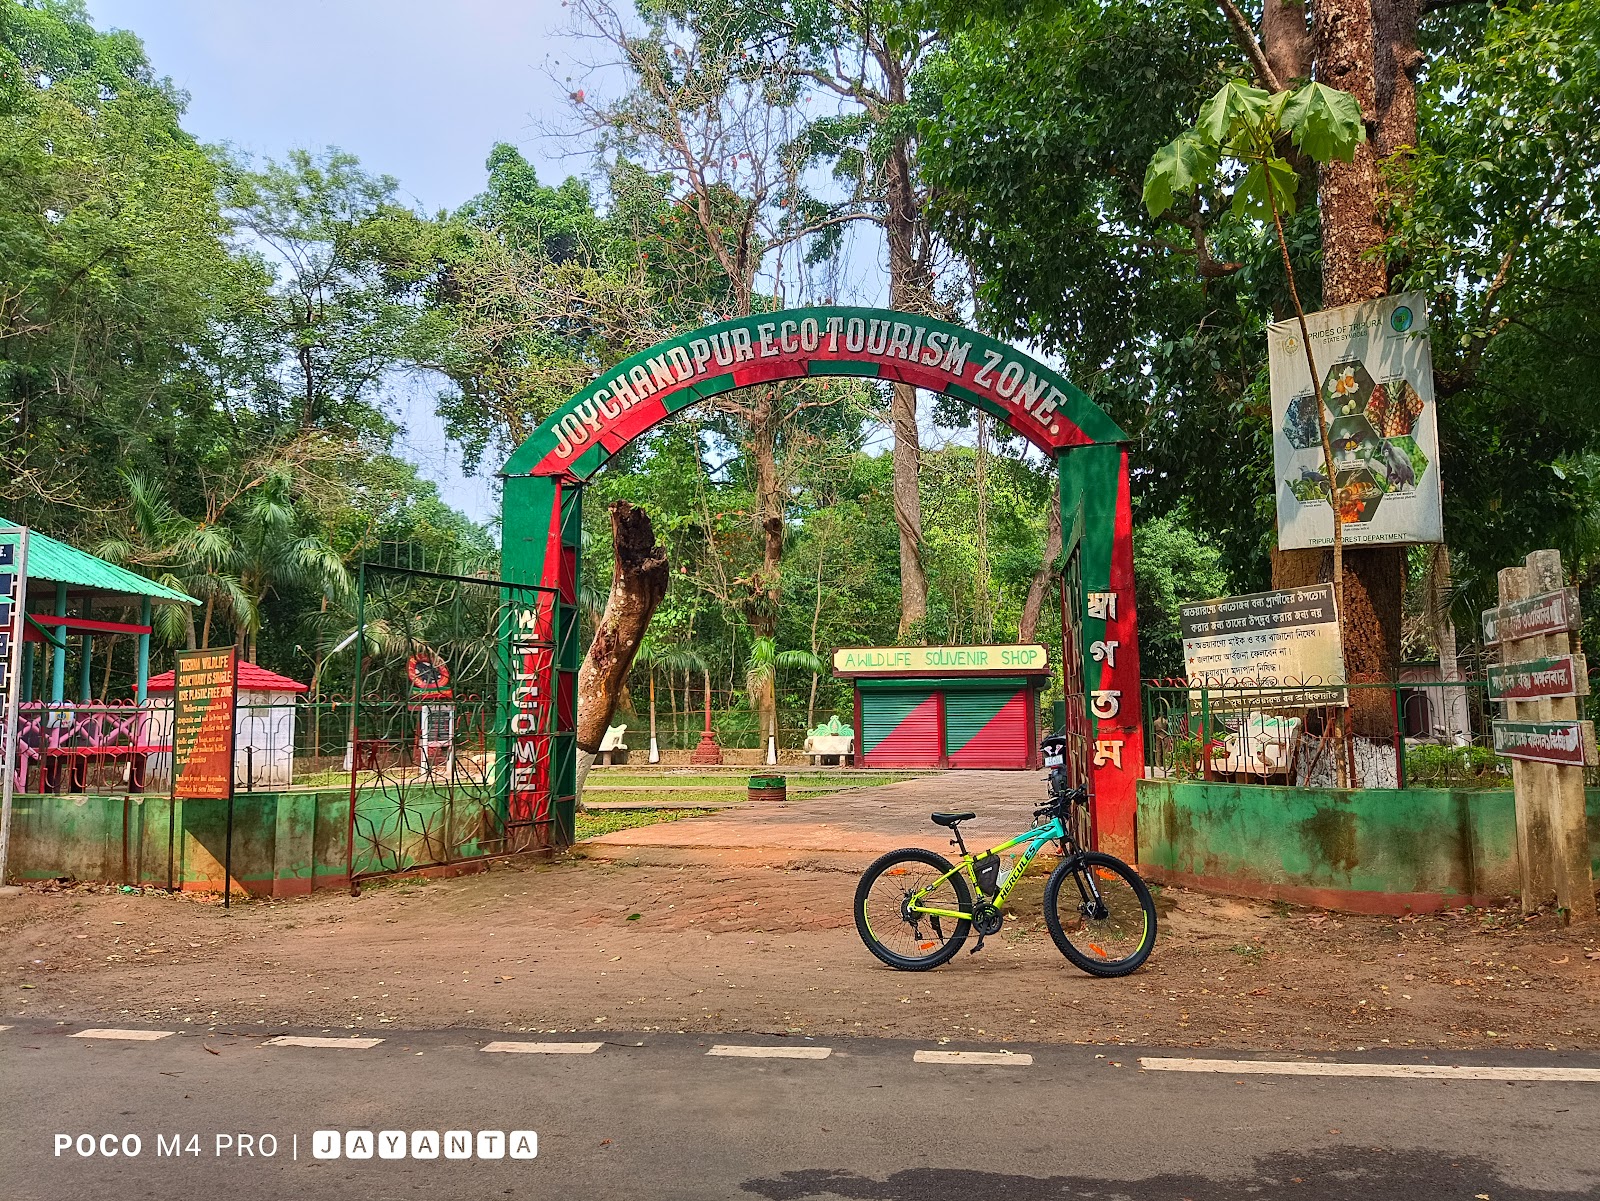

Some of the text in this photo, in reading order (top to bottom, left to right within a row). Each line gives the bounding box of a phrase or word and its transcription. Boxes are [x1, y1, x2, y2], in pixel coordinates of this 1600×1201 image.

[1308, 318, 1383, 341] PRIDES OF TRIPURA
[1323, 330, 1368, 345] STATE SYMBOLS
[550, 327, 755, 459] JOYCHANDPUR
[1342, 535, 1362, 543] OREST
[1363, 532, 1407, 542] DEPARTMENT
[925, 650, 989, 666] SOUVENIR
[1001, 649, 1038, 665] SHOP
[1000, 844, 1036, 901] HERCULES
